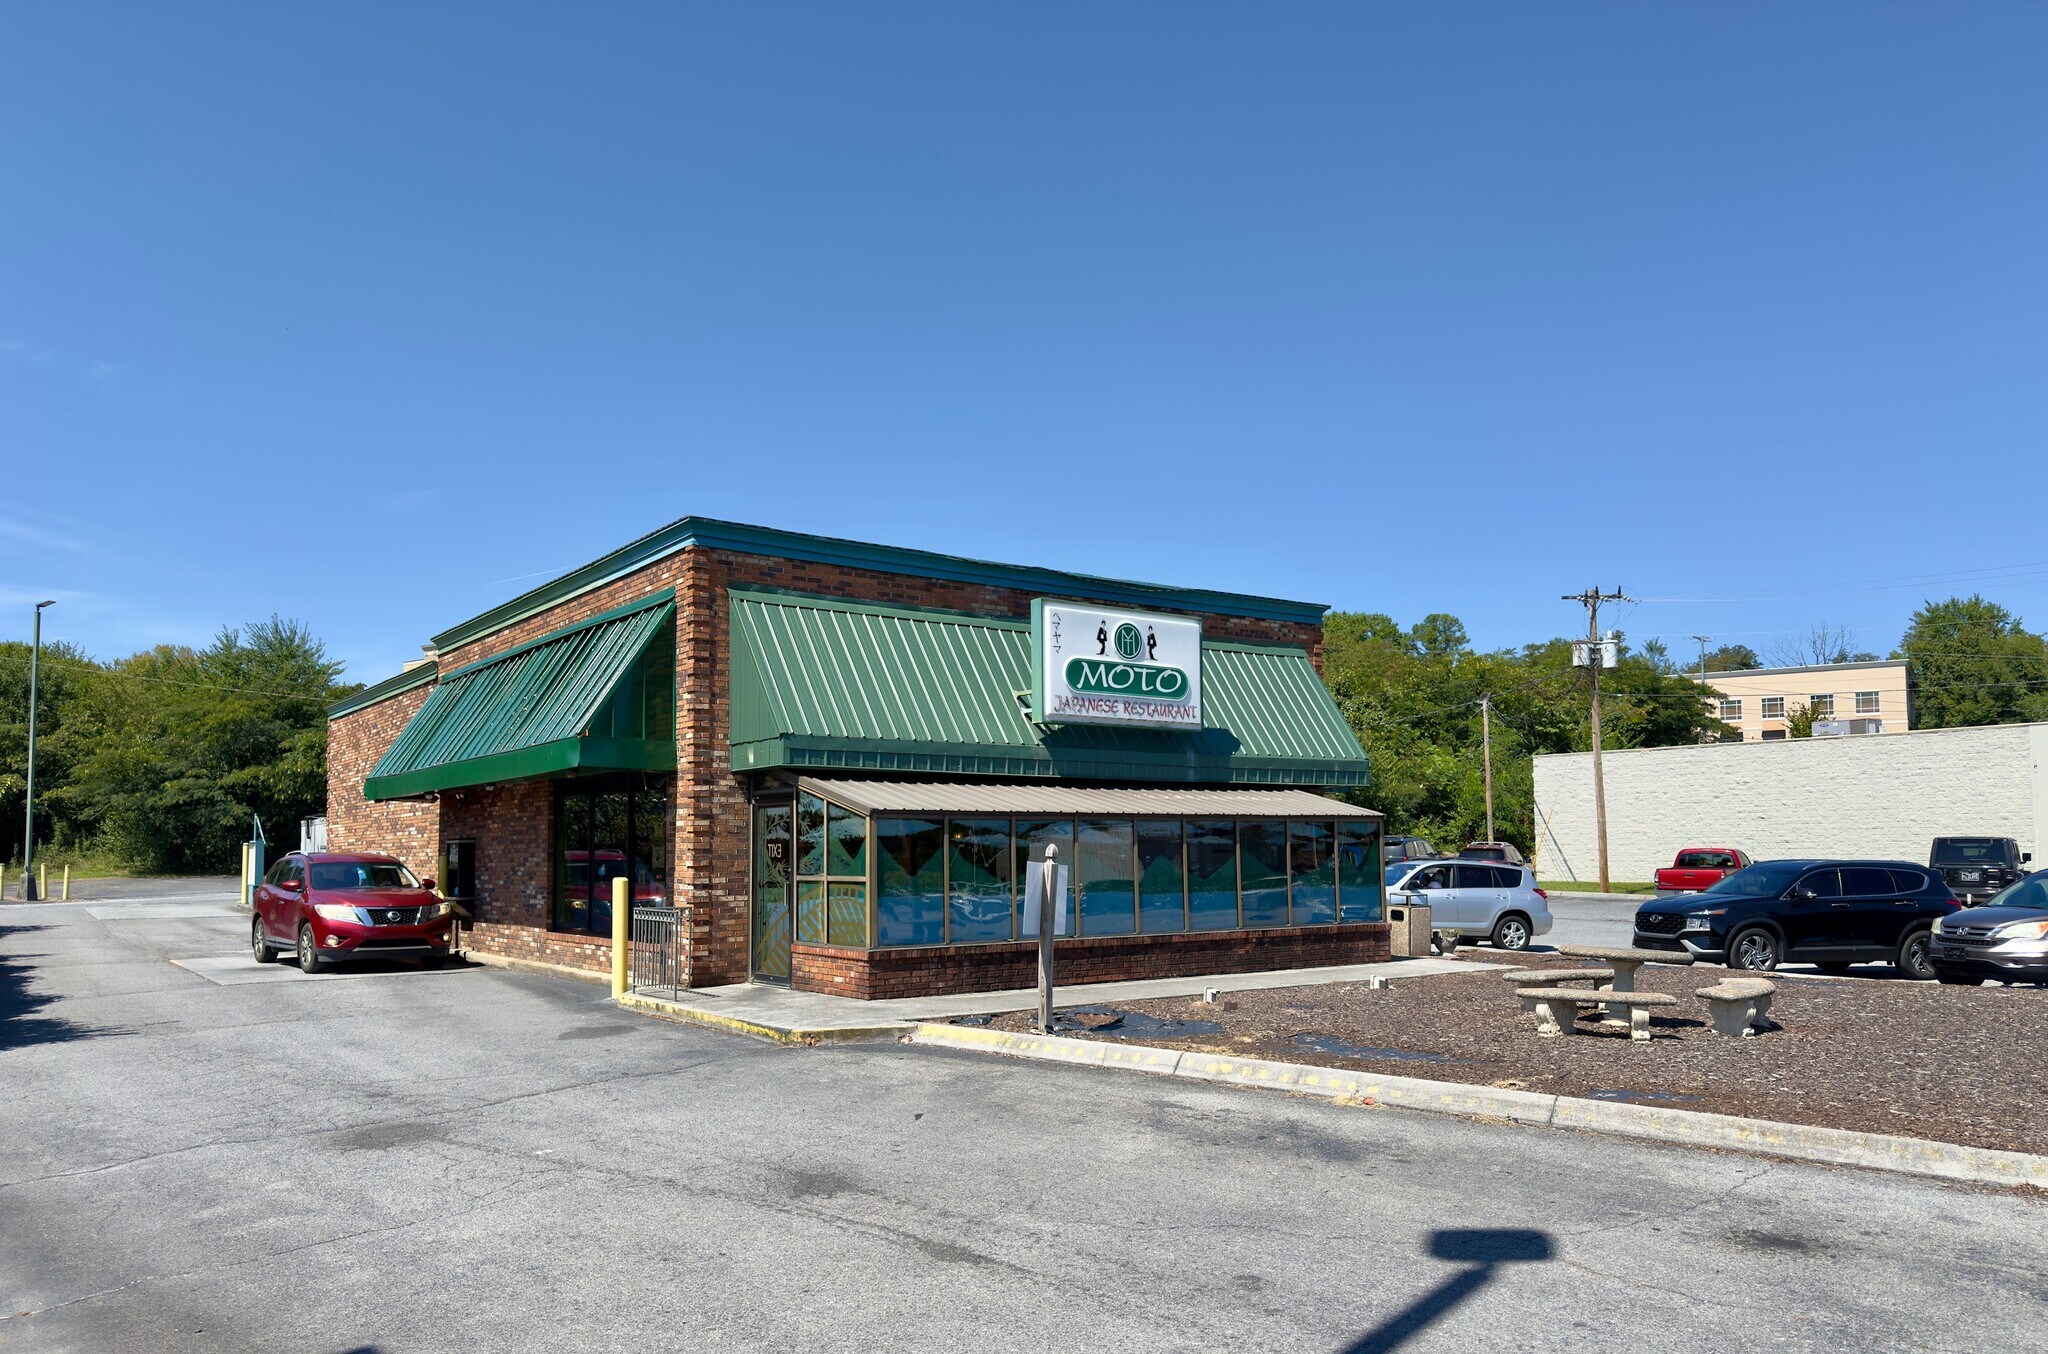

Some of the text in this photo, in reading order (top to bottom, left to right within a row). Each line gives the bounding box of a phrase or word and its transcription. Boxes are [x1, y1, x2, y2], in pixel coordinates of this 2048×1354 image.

[1076, 661, 1183, 693] MOTO
[1053, 694, 1198, 720] JAPANESE RESTAURANT
